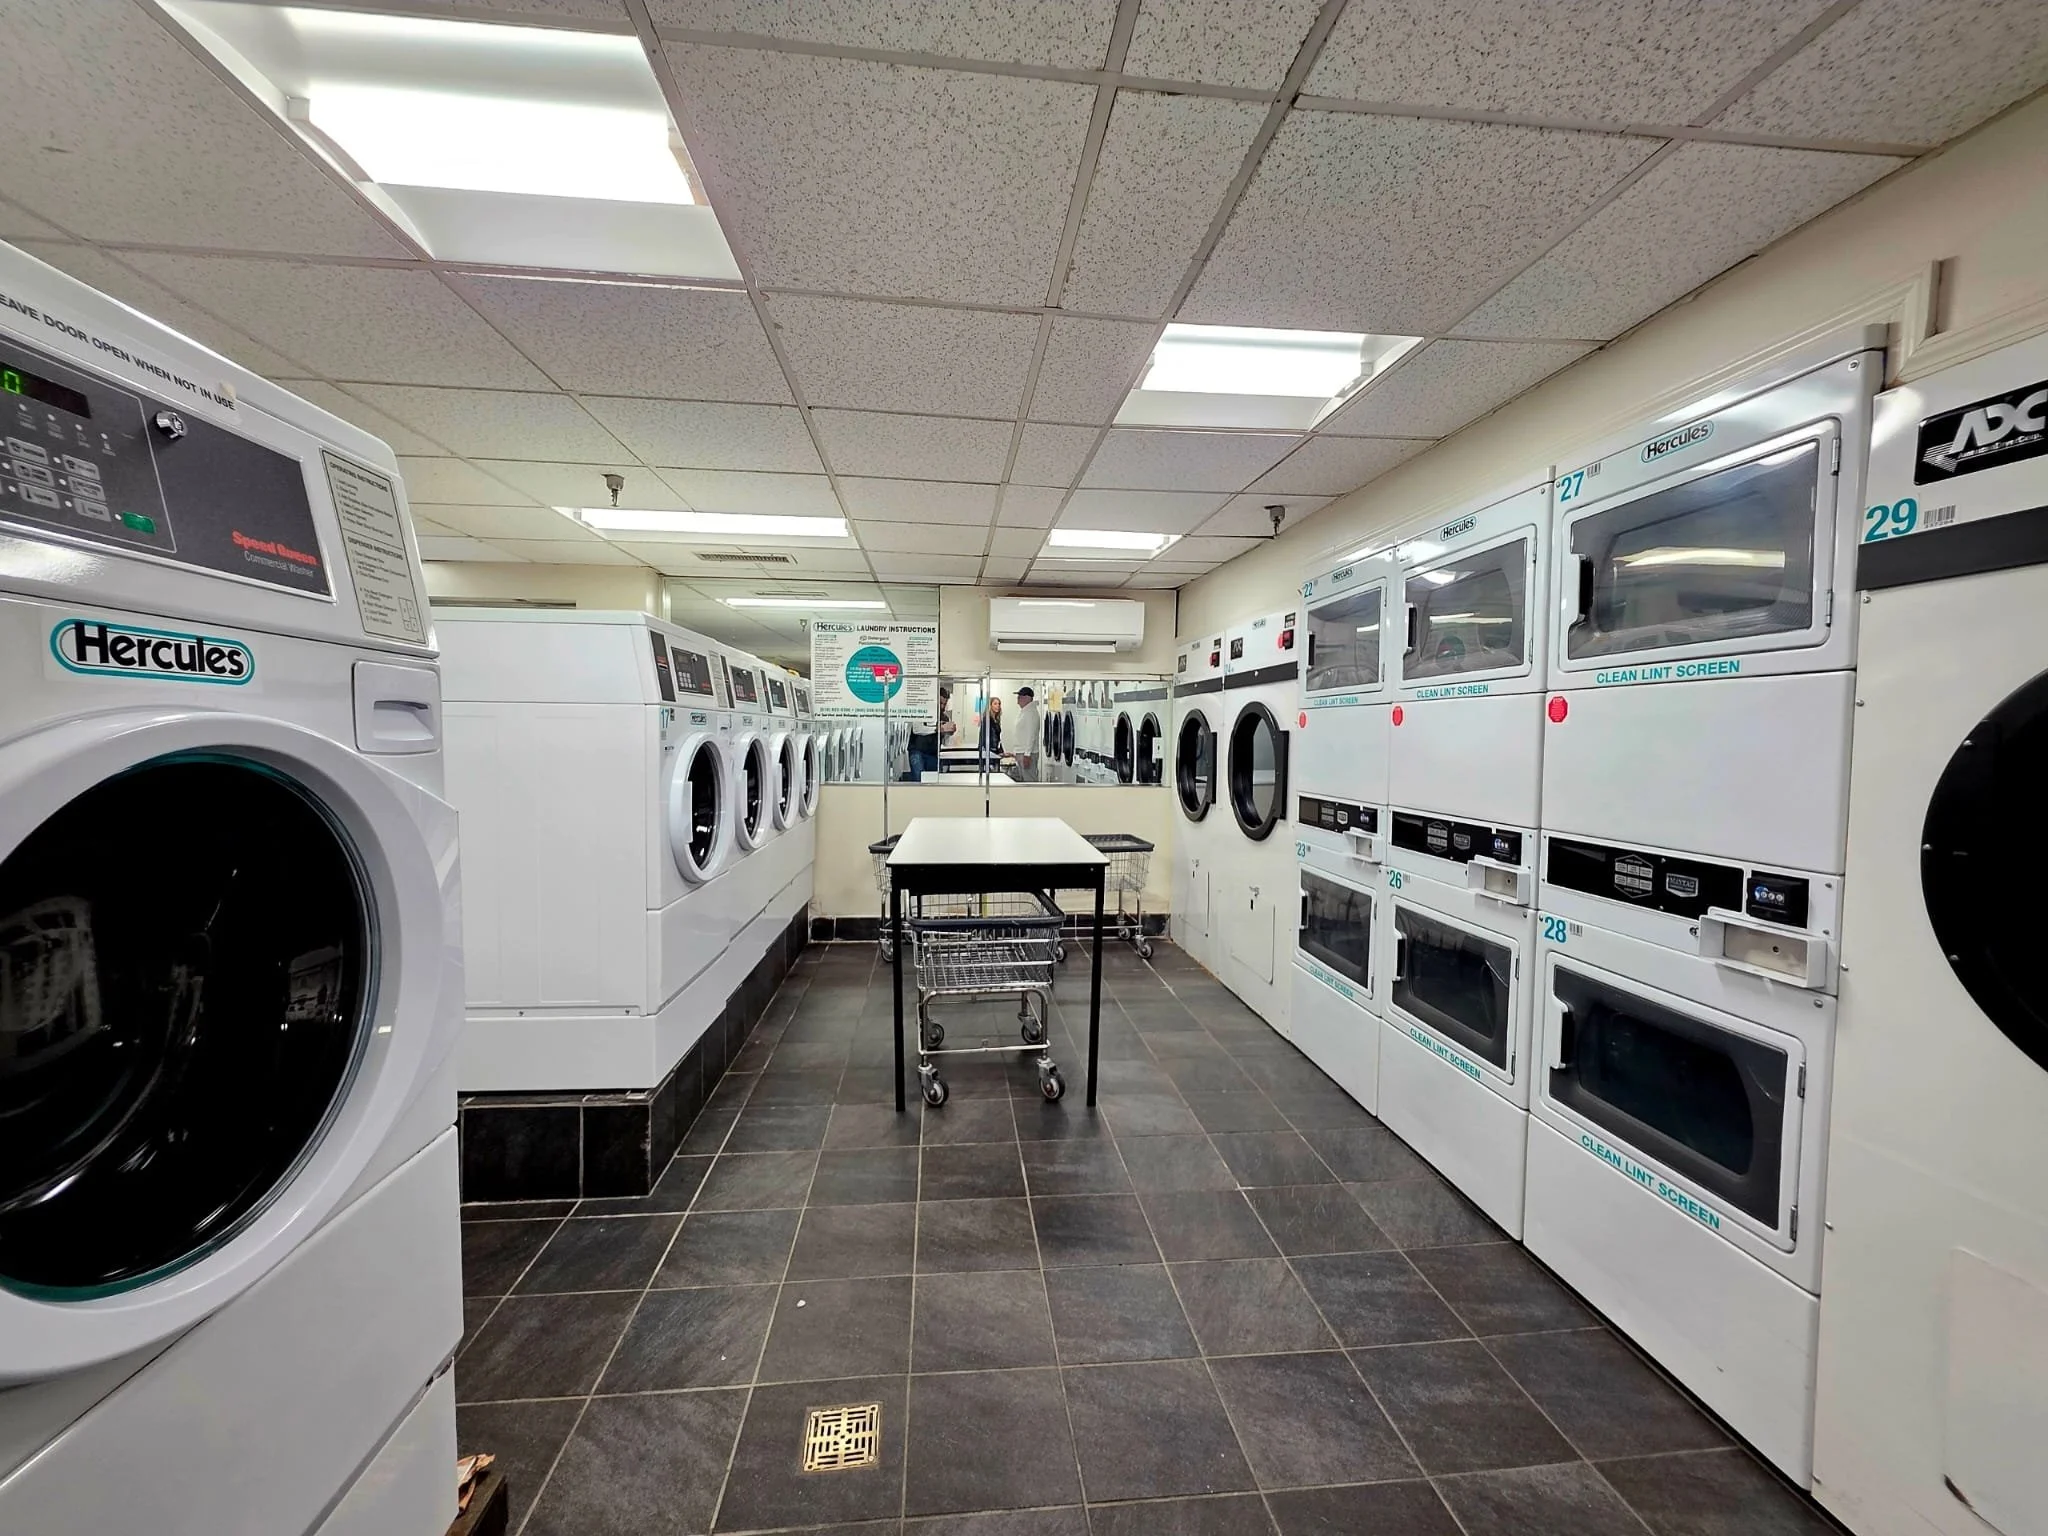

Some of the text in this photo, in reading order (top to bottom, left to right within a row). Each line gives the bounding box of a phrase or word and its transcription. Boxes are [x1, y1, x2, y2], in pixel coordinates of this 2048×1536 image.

[43, 313, 89, 344] DOOR
[92, 337, 130, 363] OPEN
[133, 355, 171, 382] WHEN
[174, 375, 197, 393] NOT
[200, 386, 212, 400] IN
[214, 394, 236, 411] USE
[1950, 388, 2048, 452] ADC
[1647, 424, 1708, 459] Hercules
[1560, 471, 1584, 501] 27
[1443, 517, 1474, 538] Hercules
[1864, 498, 1917, 542] 29
[232, 530, 317, 566] Speed Queen
[244, 550, 288, 571] Commercial
[1304, 582, 1313, 598] 22
[816, 622, 853, 632] Hercules
[74, 622, 244, 676] Hercules
[1597, 660, 1740, 684] CLEAN LINT SCREEN
[1416, 685, 1489, 698] CLEAN LINT SCREEN
[1297, 842, 1306, 857] 23
[1389, 870, 1402, 888] 26
[1544, 917, 1567, 943] 28
[1310, 965, 1353, 998] CLEAN LINT SCREEN
[1410, 1028, 1481, 1079] CLEAN LINT SCREEN
[1582, 1135, 1720, 1229] CLEAN LINT SCREEN
